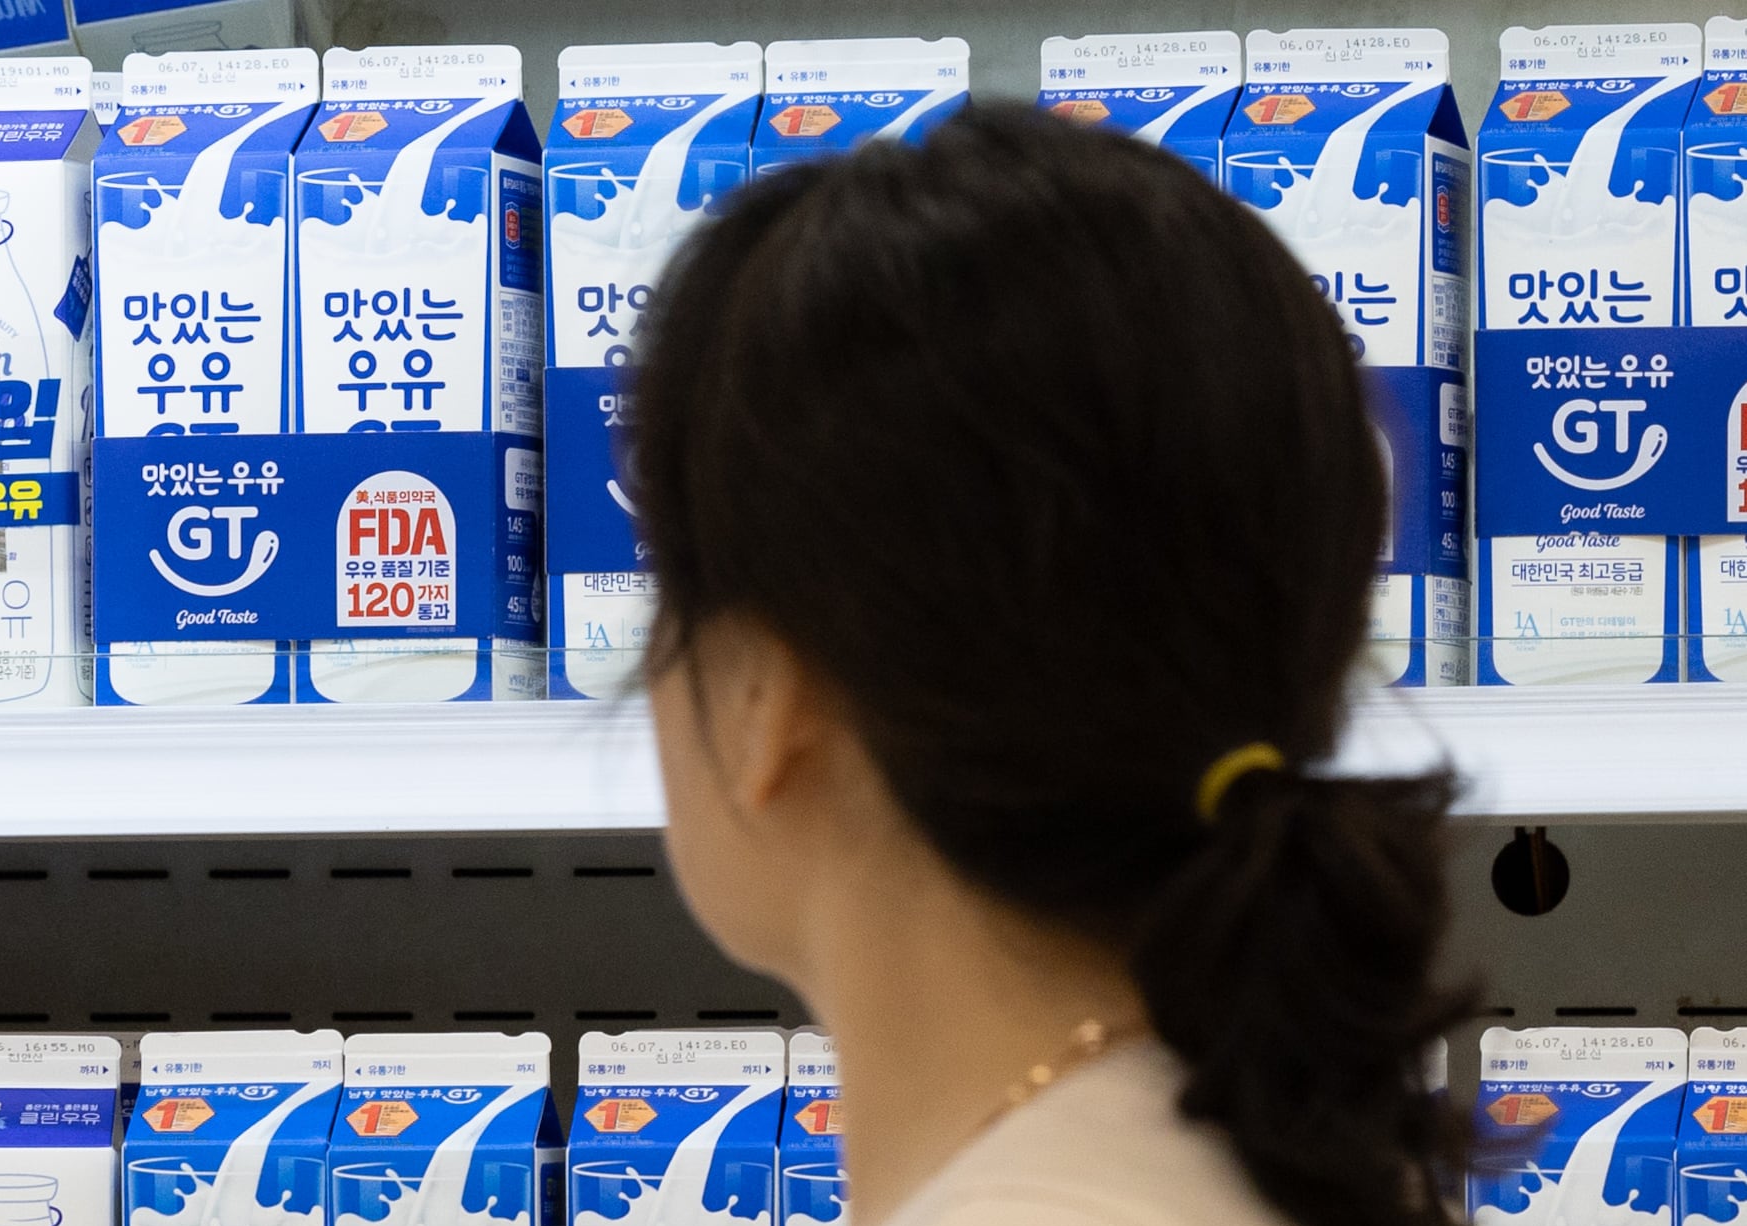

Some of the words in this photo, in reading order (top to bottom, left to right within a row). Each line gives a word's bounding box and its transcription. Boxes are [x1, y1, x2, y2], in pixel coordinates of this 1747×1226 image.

[130, 83, 167, 95] 유통기한
[278, 80, 297, 92] 까지
[1509, 270, 1652, 326] 맛있는
[124, 291, 260, 345] 맛있는
[138, 352, 243, 413] 우유
[1526, 356, 1611, 390] 맛있는
[1615, 354, 1674, 389] 우유
[1553, 398, 1647, 454] GT
[142, 462, 223, 497] 맛있는
[228, 461, 284, 496] 우유
[1560, 503, 1602, 524] Good
[1603, 502, 1645, 520] Taste
[167, 506, 259, 561] GT
[349, 508, 447, 556] FDA
[345, 560, 377, 578] 우유
[381, 560, 413, 578] 품질
[417, 560, 451, 578] 기준
[1512, 562, 1575, 583] 대한민국
[1578, 562, 1644, 582] 최고등급
[347, 582, 415, 617] 120
[418, 584, 449, 601] 가지
[175, 608, 217, 629] Good
[218, 607, 258, 626] Taste
[417, 603, 450, 620] 통과
[1489, 1060, 1528, 1071] 유통기한
[1645, 1061, 1665, 1071] 까지
